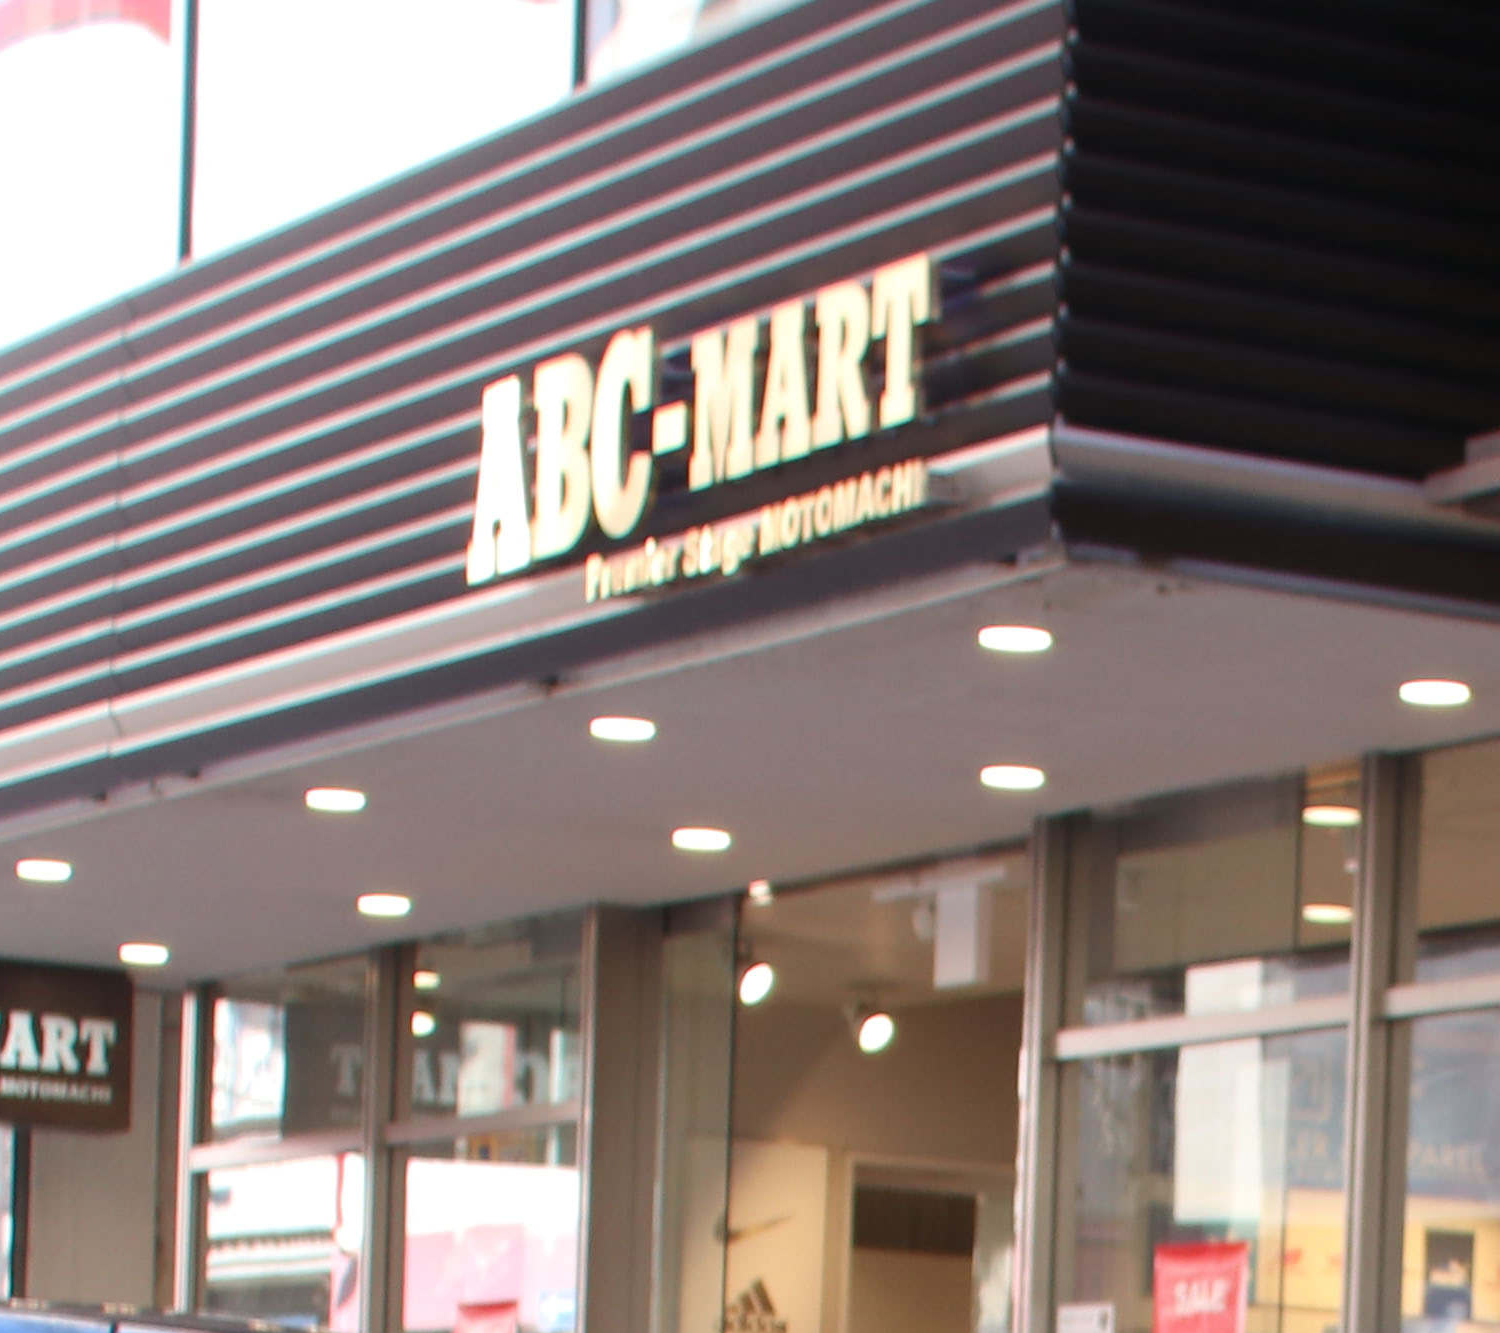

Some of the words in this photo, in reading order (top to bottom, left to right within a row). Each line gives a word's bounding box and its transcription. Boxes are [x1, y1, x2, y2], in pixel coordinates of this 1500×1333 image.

[467, 253, 930, 586] ABC-MART
[759, 457, 927, 556] MOTOMACHI
[0, 1074, 113, 1104] MOTOMACHI
[1174, 1279, 1229, 1317] SALE
